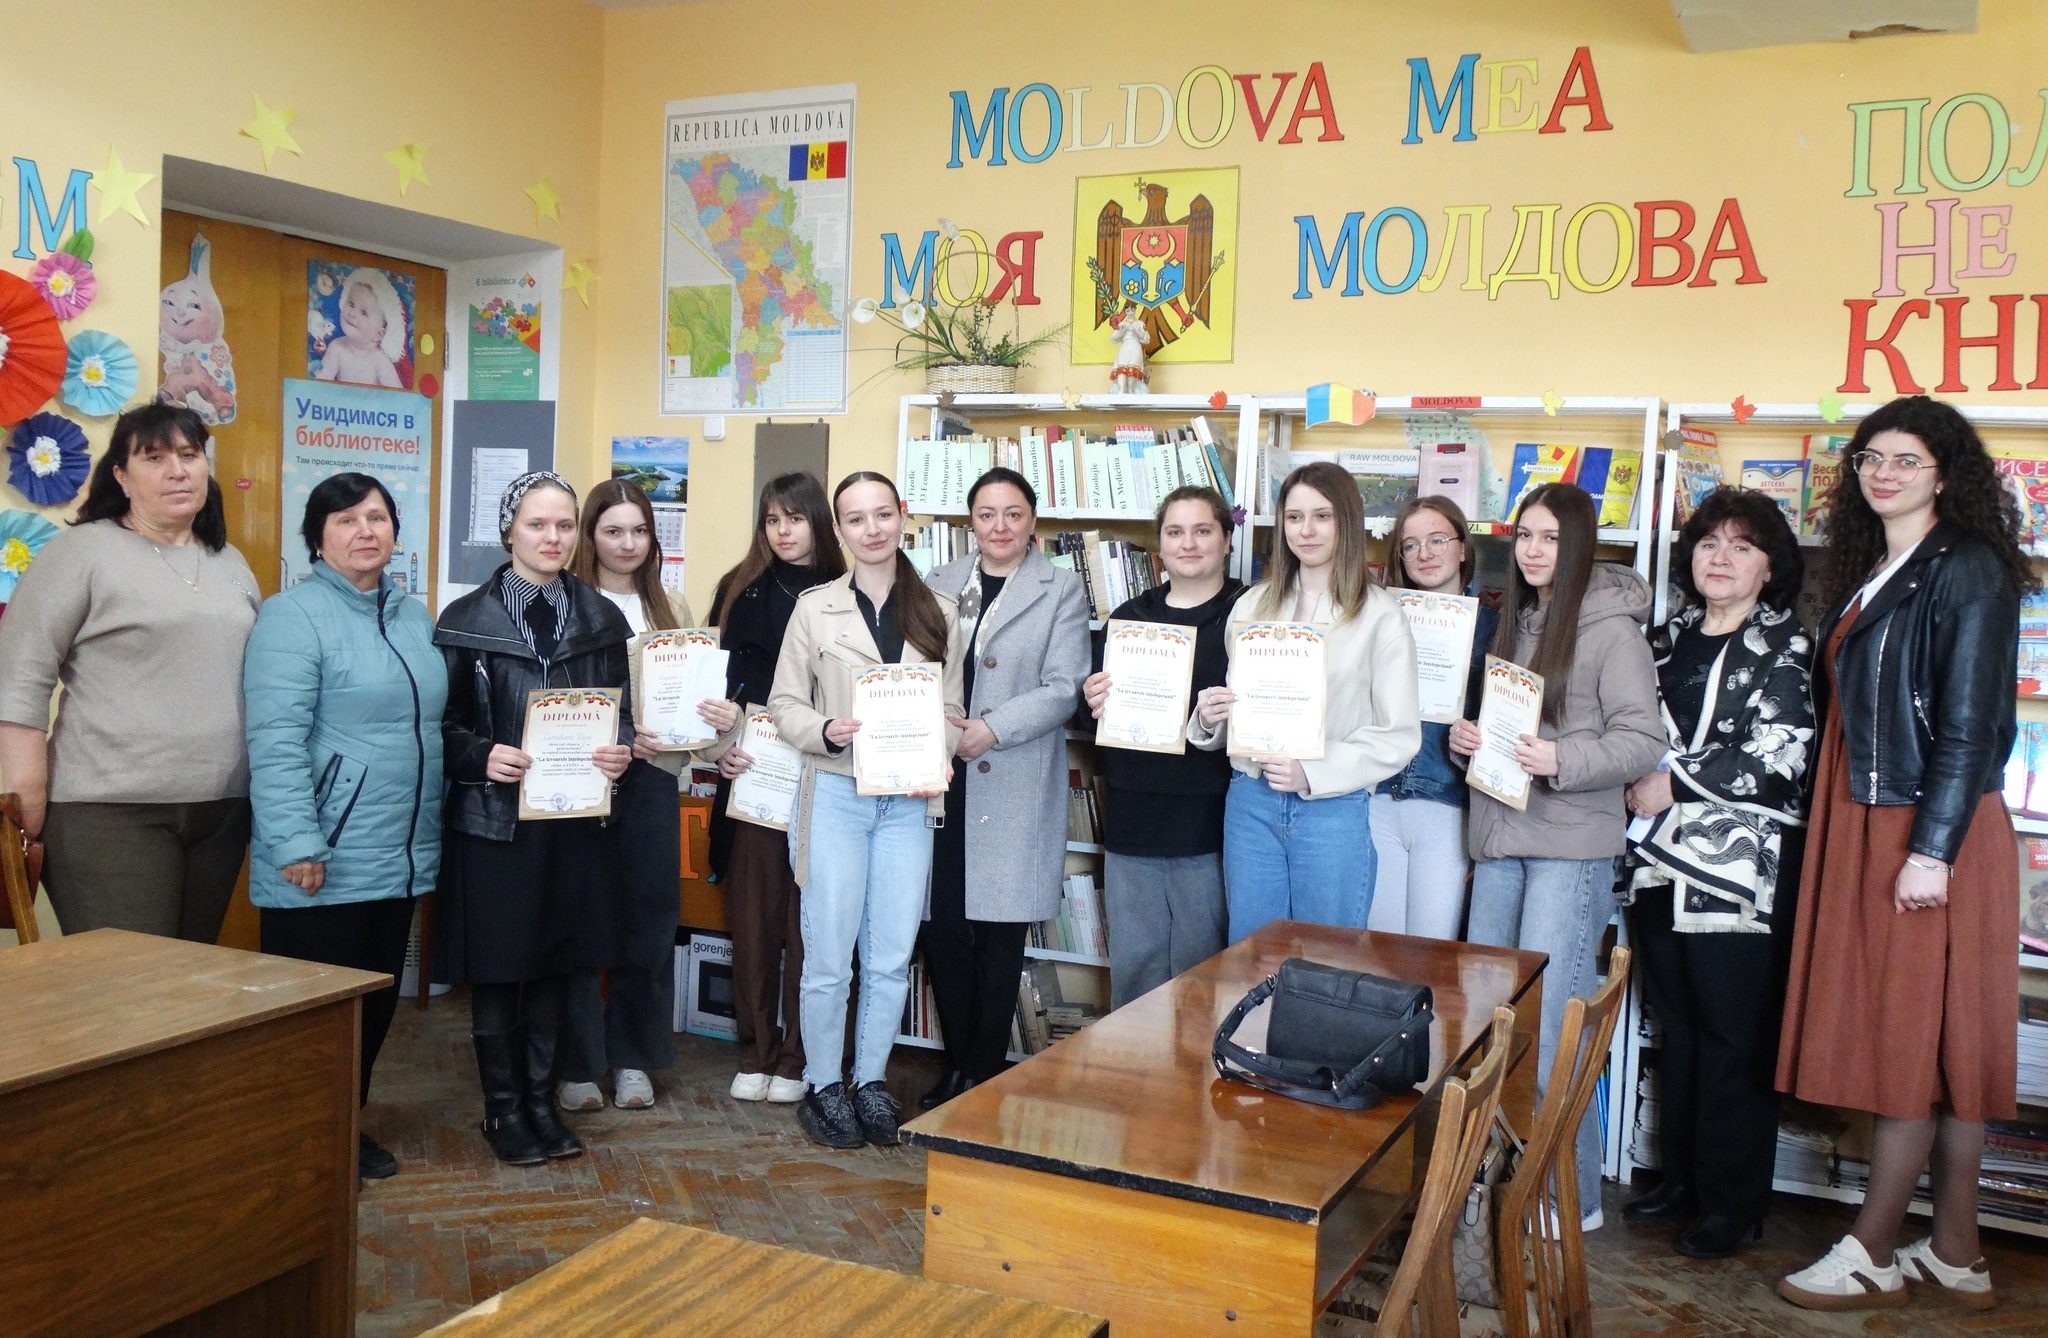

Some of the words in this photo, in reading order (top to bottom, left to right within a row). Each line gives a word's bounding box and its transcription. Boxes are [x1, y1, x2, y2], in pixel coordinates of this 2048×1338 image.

[946, 62, 1345, 169] MOLDOVA
[1401, 46, 1613, 145] MEA
[674, 118, 759, 143] REPUBLICA
[769, 110, 844, 135] MOLDOVA
[879, 229, 1044, 309] МОЯ
[1293, 198, 1767, 301] МОЛДОВА
[1872, 198, 2017, 297] НЕ
[481, 277, 517, 286] biblioteca
[295, 397, 398, 429] Увидимся
[403, 414, 414, 429] в
[1419, 397, 1473, 407] MOLDOVA
[295, 424, 420, 455] библиотеке!
[296, 455, 310, 465] Там
[311, 458, 352, 468] происходит
[354, 461, 376, 469] что-то
[1161, 449, 1174, 491] gricultură
[1349, 453, 1370, 462] RAW
[1372, 454, 1417, 463] MOLDOVA
[1058, 459, 1067, 495] Botanica
[1113, 456, 1125, 495] Medicina
[1812, 475, 1840, 487] ПОЛ
[654, 652, 688, 663] DIPLO
[693, 940, 733, 958] gorenje
